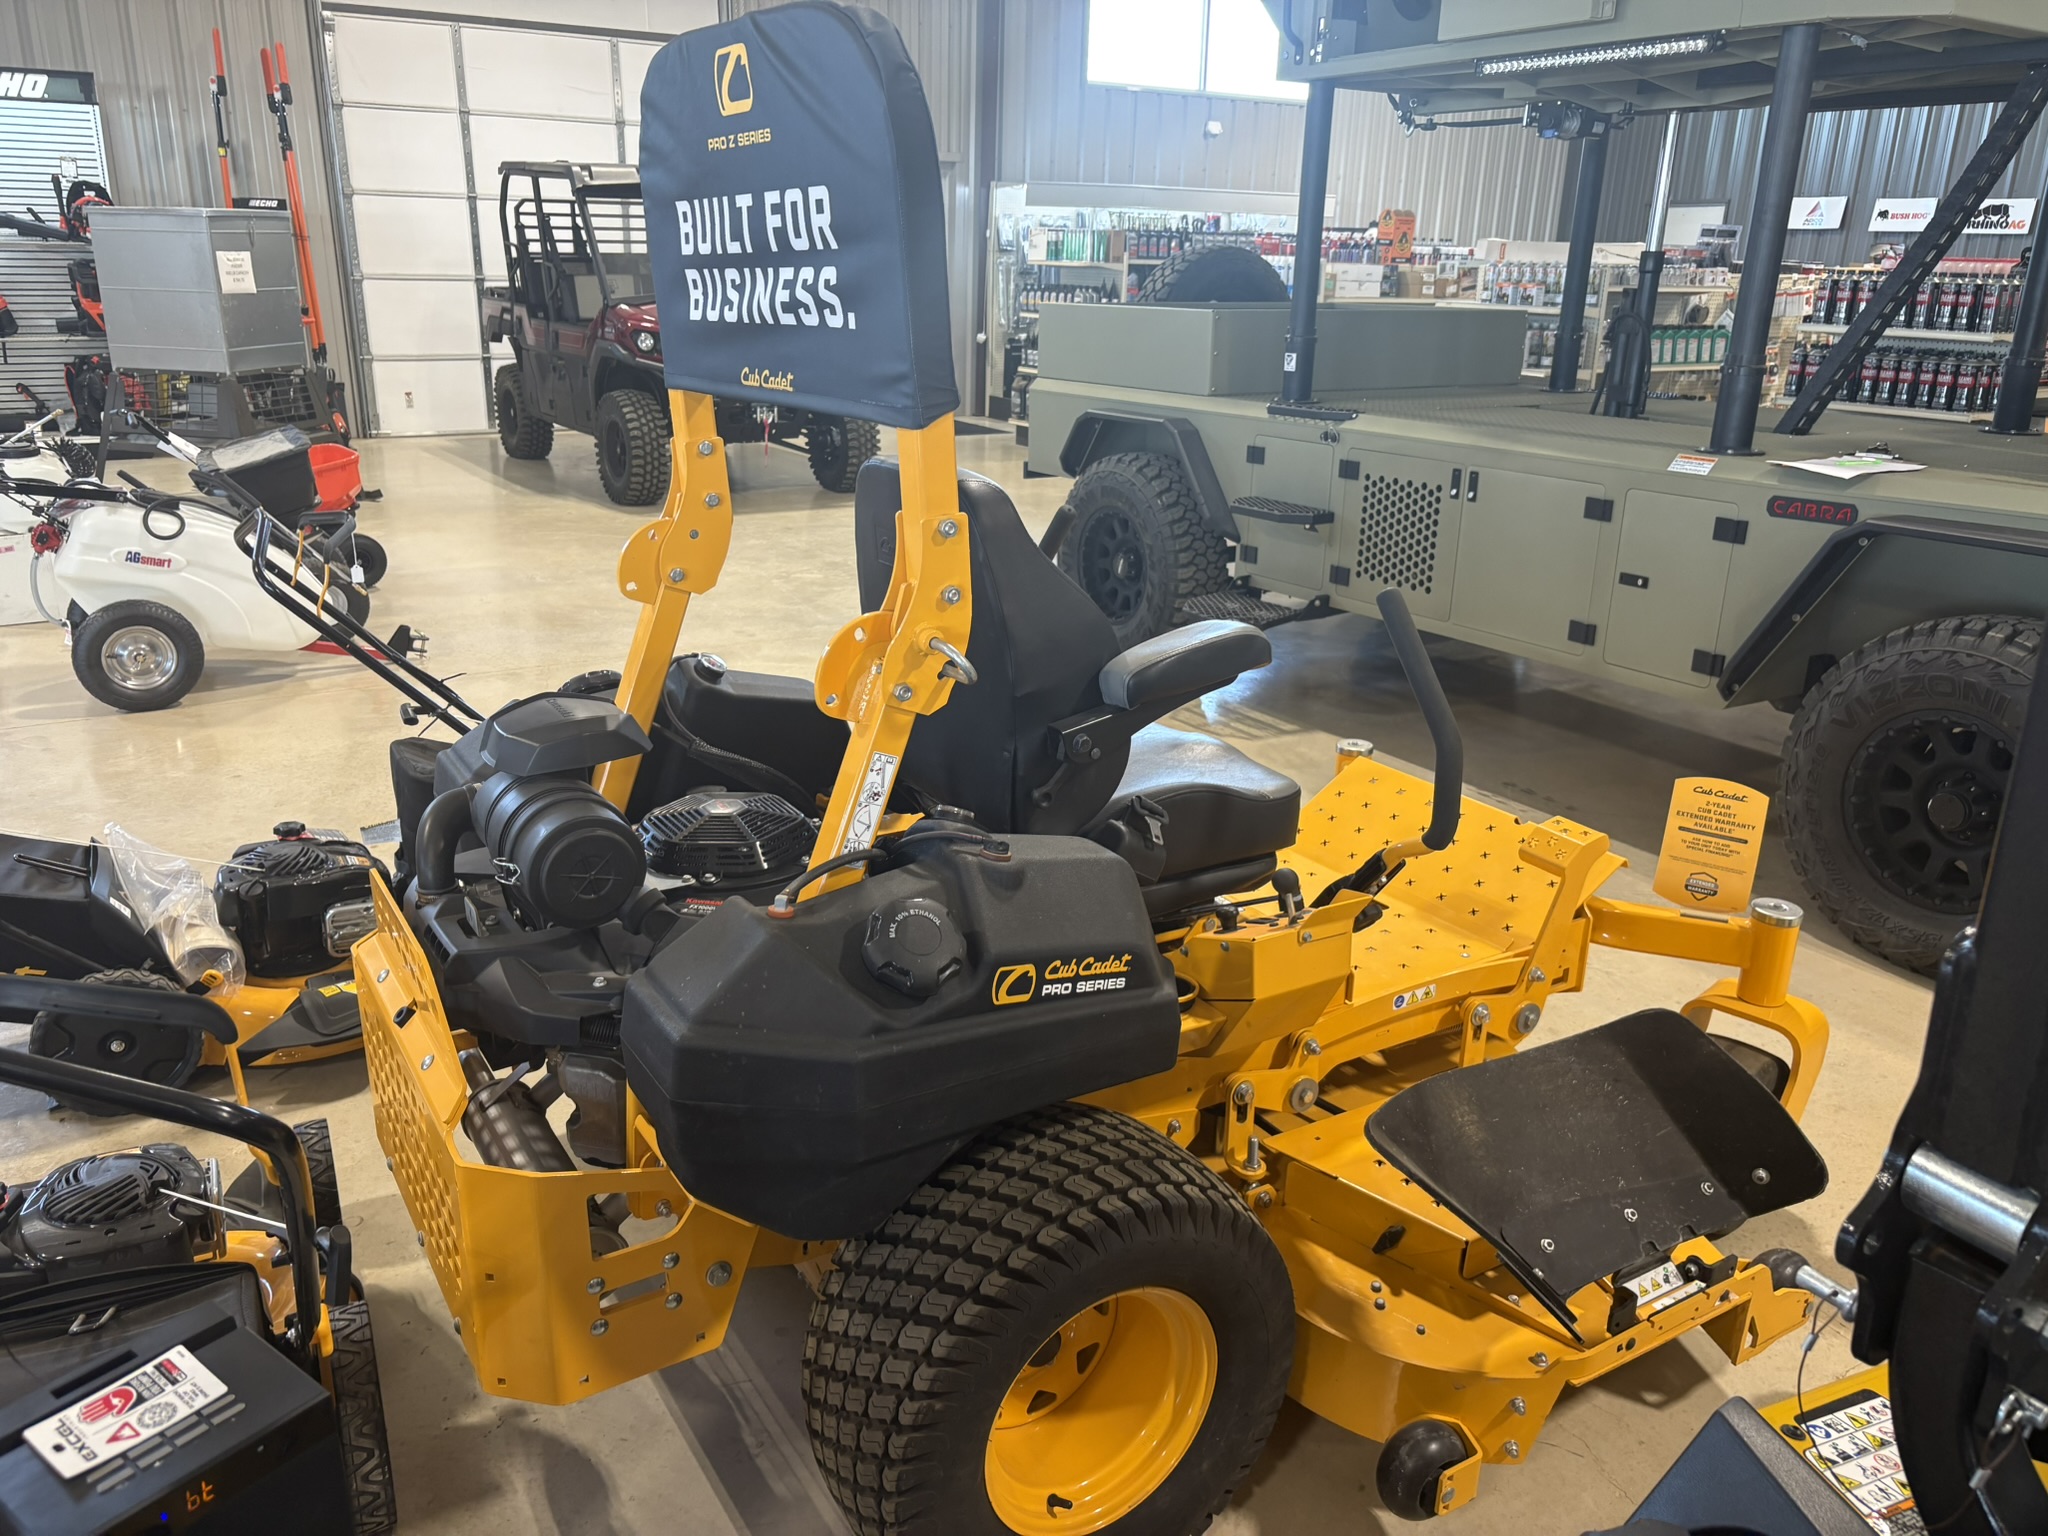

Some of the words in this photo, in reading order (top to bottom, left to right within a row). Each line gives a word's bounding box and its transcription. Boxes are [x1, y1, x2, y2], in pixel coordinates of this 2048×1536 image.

[0, 71, 49, 98] HO
[708, 136, 727, 152] PRO
[728, 134, 736, 148] Z
[737, 128, 772, 146] SERIES
[255, 200, 279, 208] ECHO
[675, 193, 754, 256] BUILT
[764, 185, 839, 253] FOR
[1911, 212, 1929, 220] HOG
[684, 266, 856, 330] BUSINESS.
[740, 366, 760, 387] Cub
[761, 369, 794, 392] Cadet
[1773, 500, 1852, 522] CABRA
[125, 551, 172, 568] AGsmart
[1693, 786, 1713, 796] Cub
[1714, 790, 1749, 803] Cadet
[1697, 807, 1712, 815] CUB
[1713, 809, 1737, 820] CADET
[1706, 801, 1731, 811] 2-YEAR
[1676, 810, 1713, 823] EXTENDED
[1715, 816, 1756, 831] WARRANTY
[1687, 885, 1715, 895] WARRANTY
[1690, 878, 1716, 888] EXTENDED
[909, 909, 941, 926] ETHANOL
[1044, 958, 1078, 980] Cub
[1079, 953, 1133, 976] Cadet
[1041, 983, 1072, 996] PRO
[1075, 977, 1126, 993] SERIES
[55, 1418, 98, 1462] EXCEL
